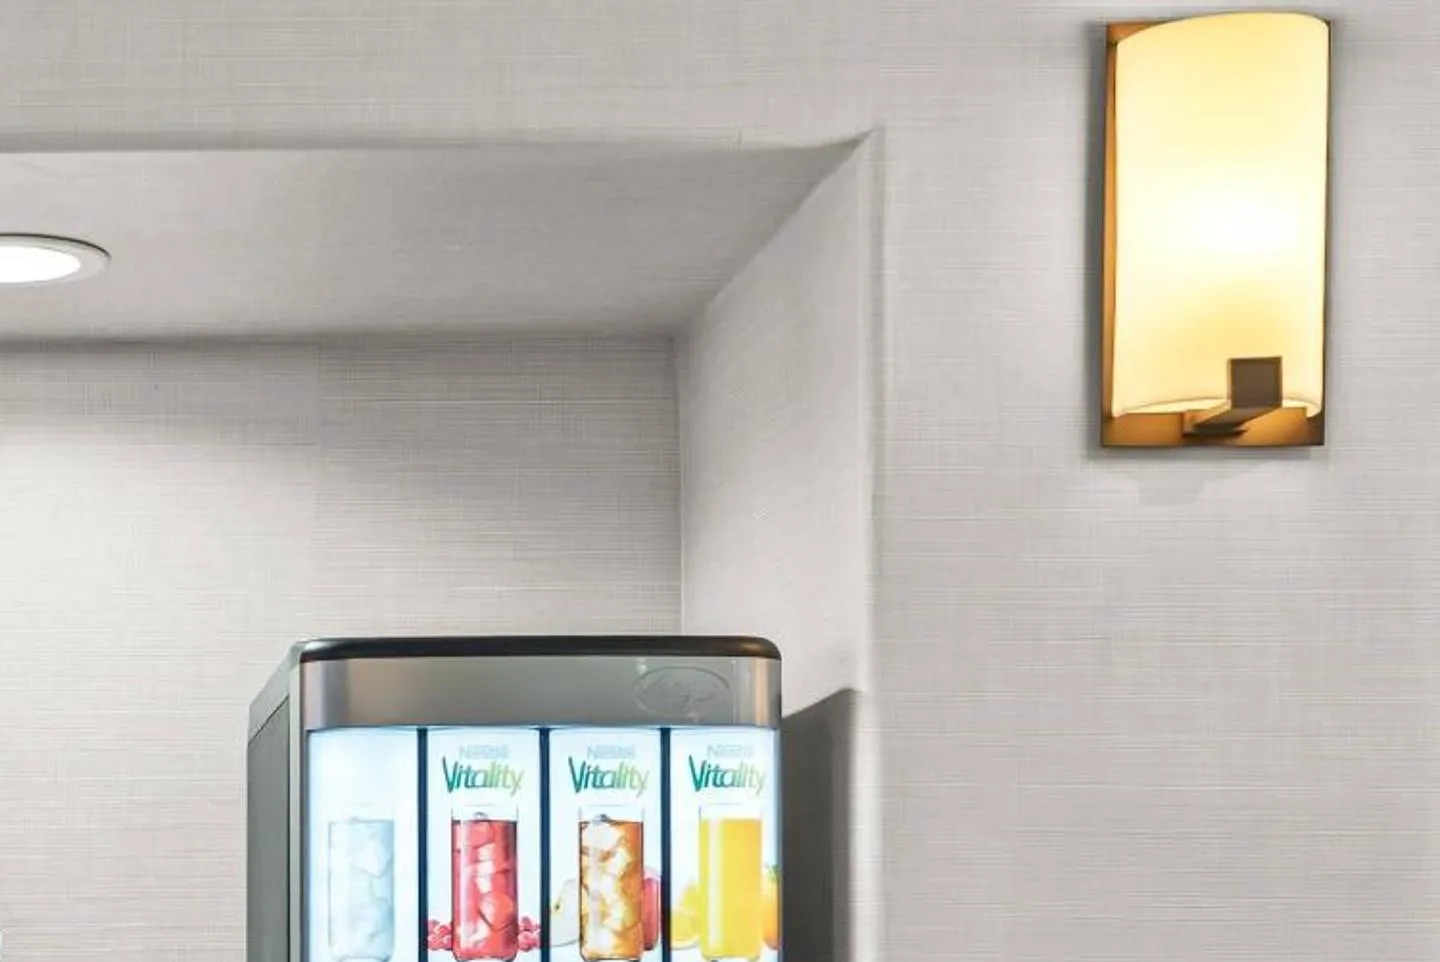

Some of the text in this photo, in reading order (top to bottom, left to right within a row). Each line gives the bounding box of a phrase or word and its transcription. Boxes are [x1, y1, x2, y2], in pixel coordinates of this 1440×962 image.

[442, 755, 524, 797] Vitality
[568, 755, 650, 799] Vitality
[688, 753, 767, 796] Vitality
